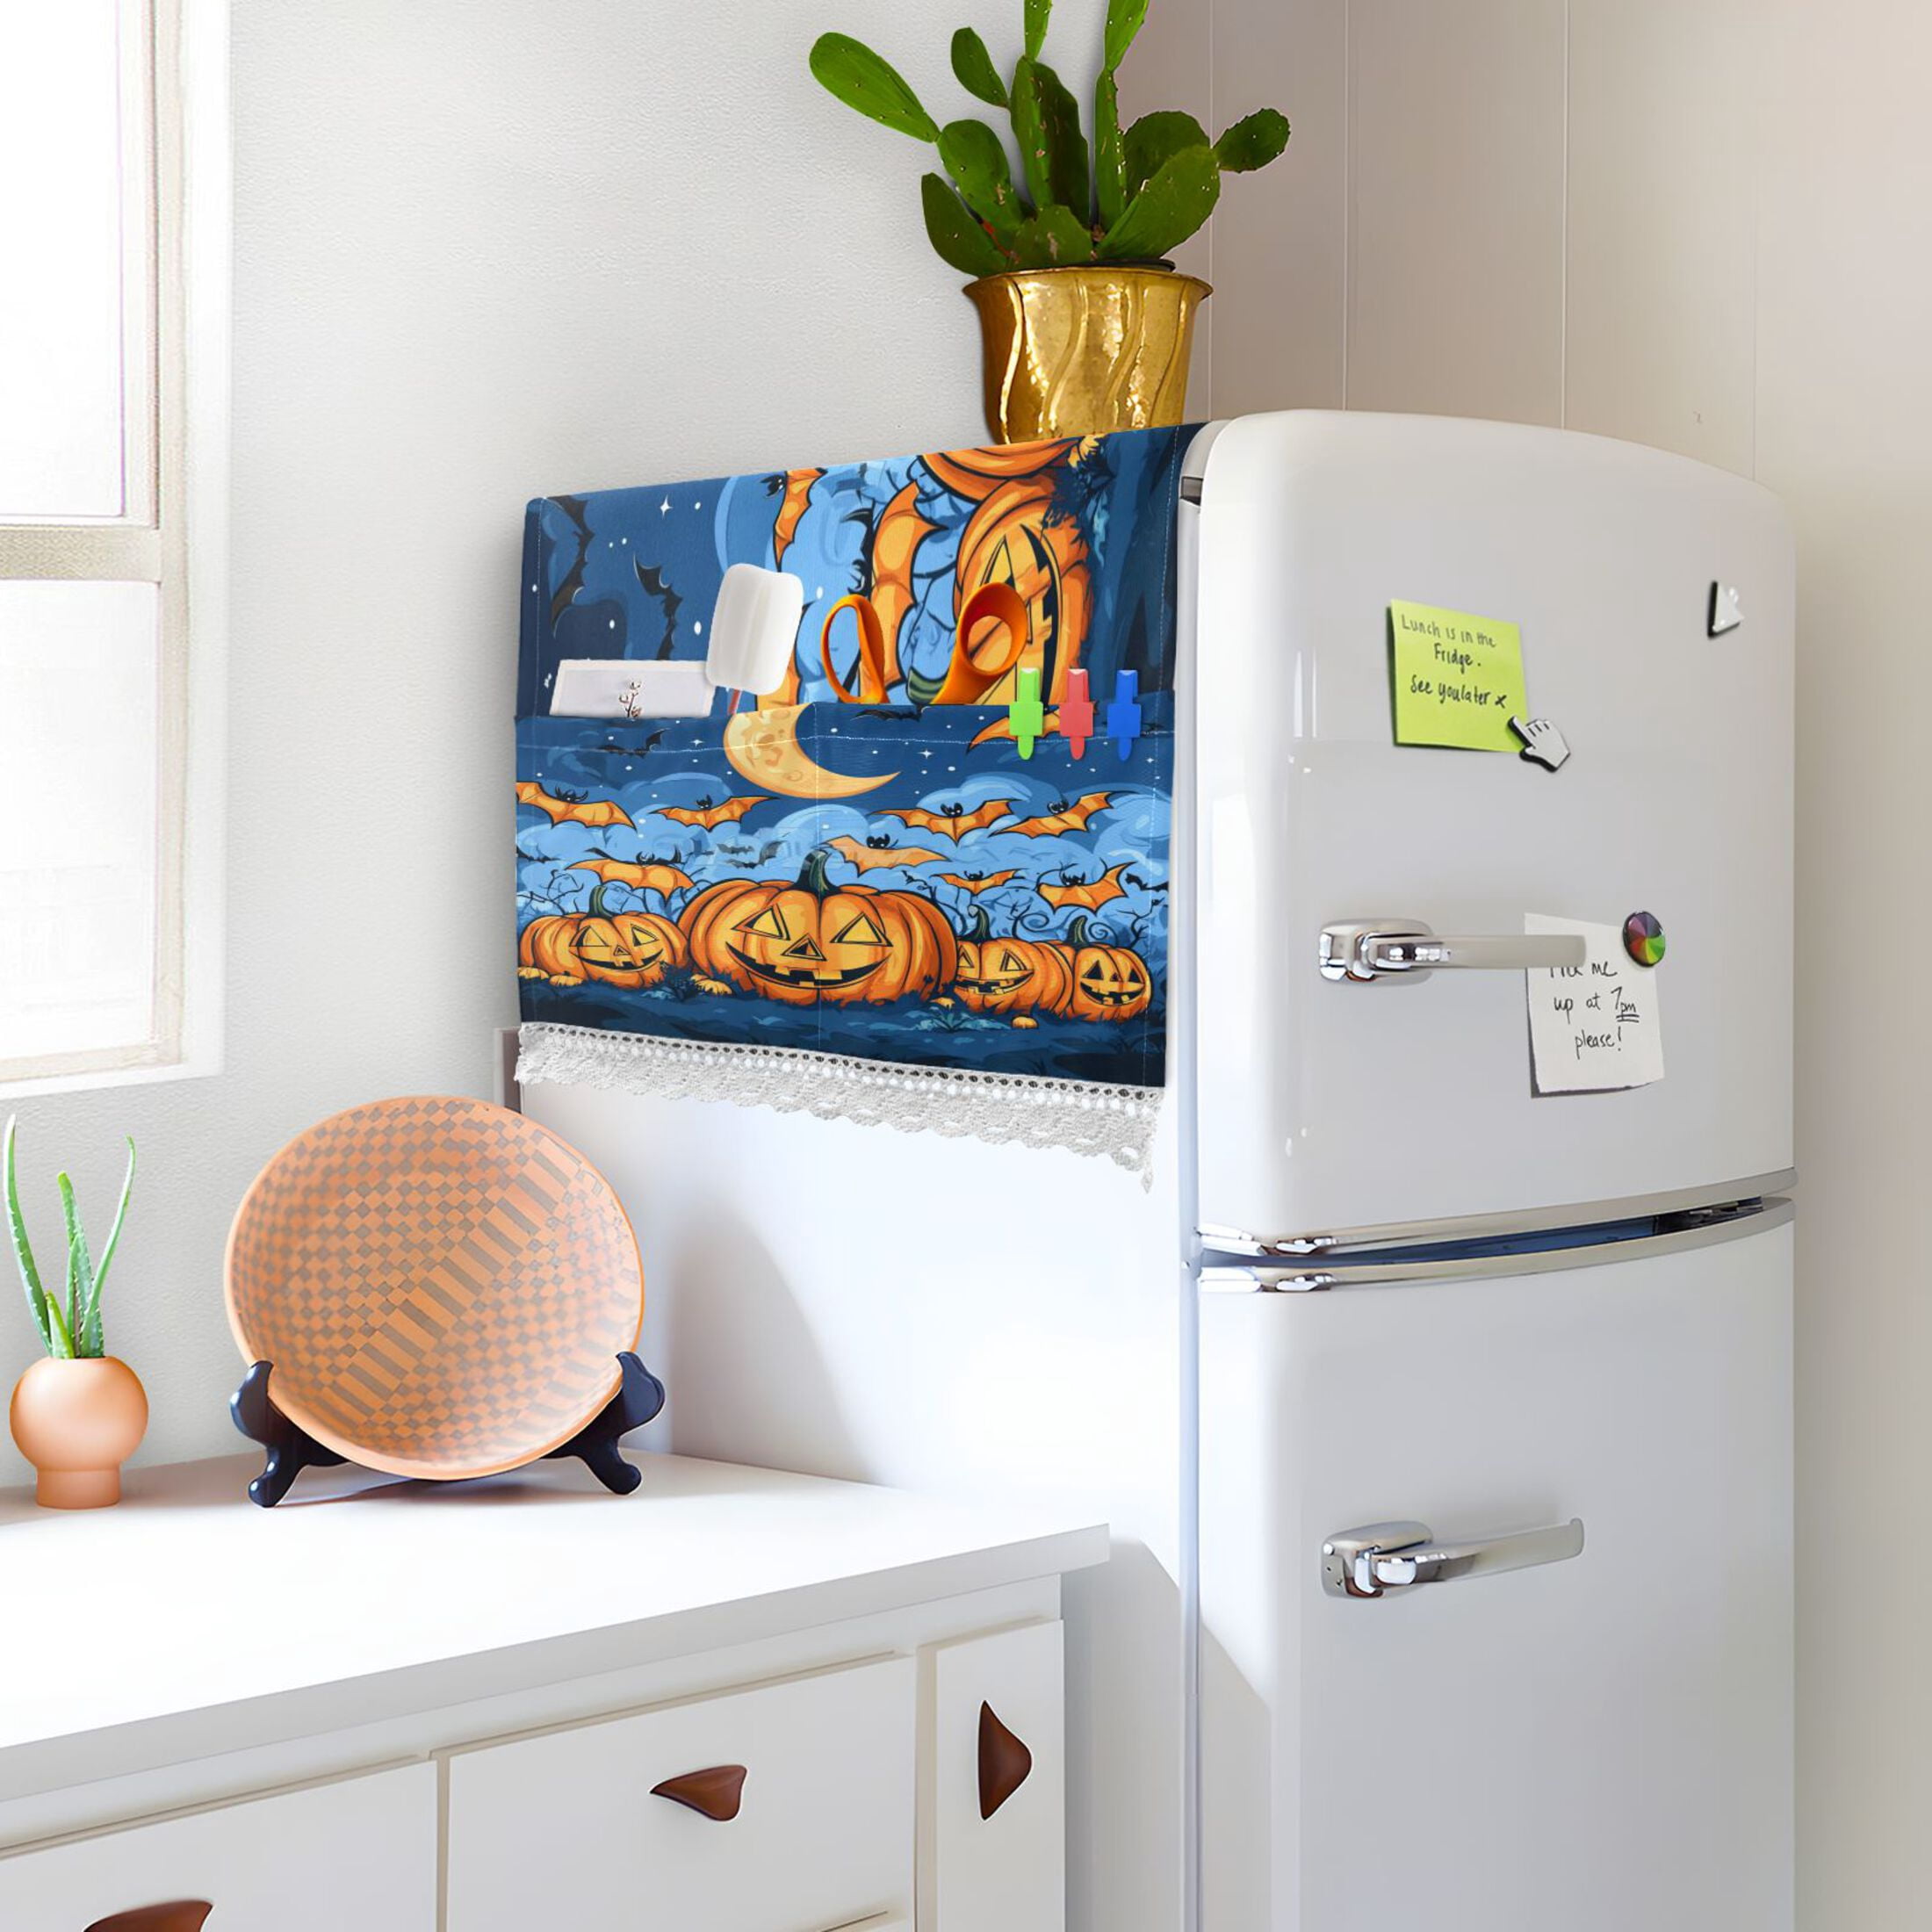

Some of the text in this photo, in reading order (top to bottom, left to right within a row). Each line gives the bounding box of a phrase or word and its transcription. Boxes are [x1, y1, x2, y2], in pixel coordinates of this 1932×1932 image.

[1402, 614, 1441, 638] Lunch
[1460, 631, 1474, 643] in
[1477, 631, 1496, 647] the
[1410, 674, 1433, 694] See
[1591, 961, 1618, 977] me
[1554, 997, 1574, 1024] up
[1586, 991, 1601, 1011] at
[1575, 1026, 1622, 1060] please!
